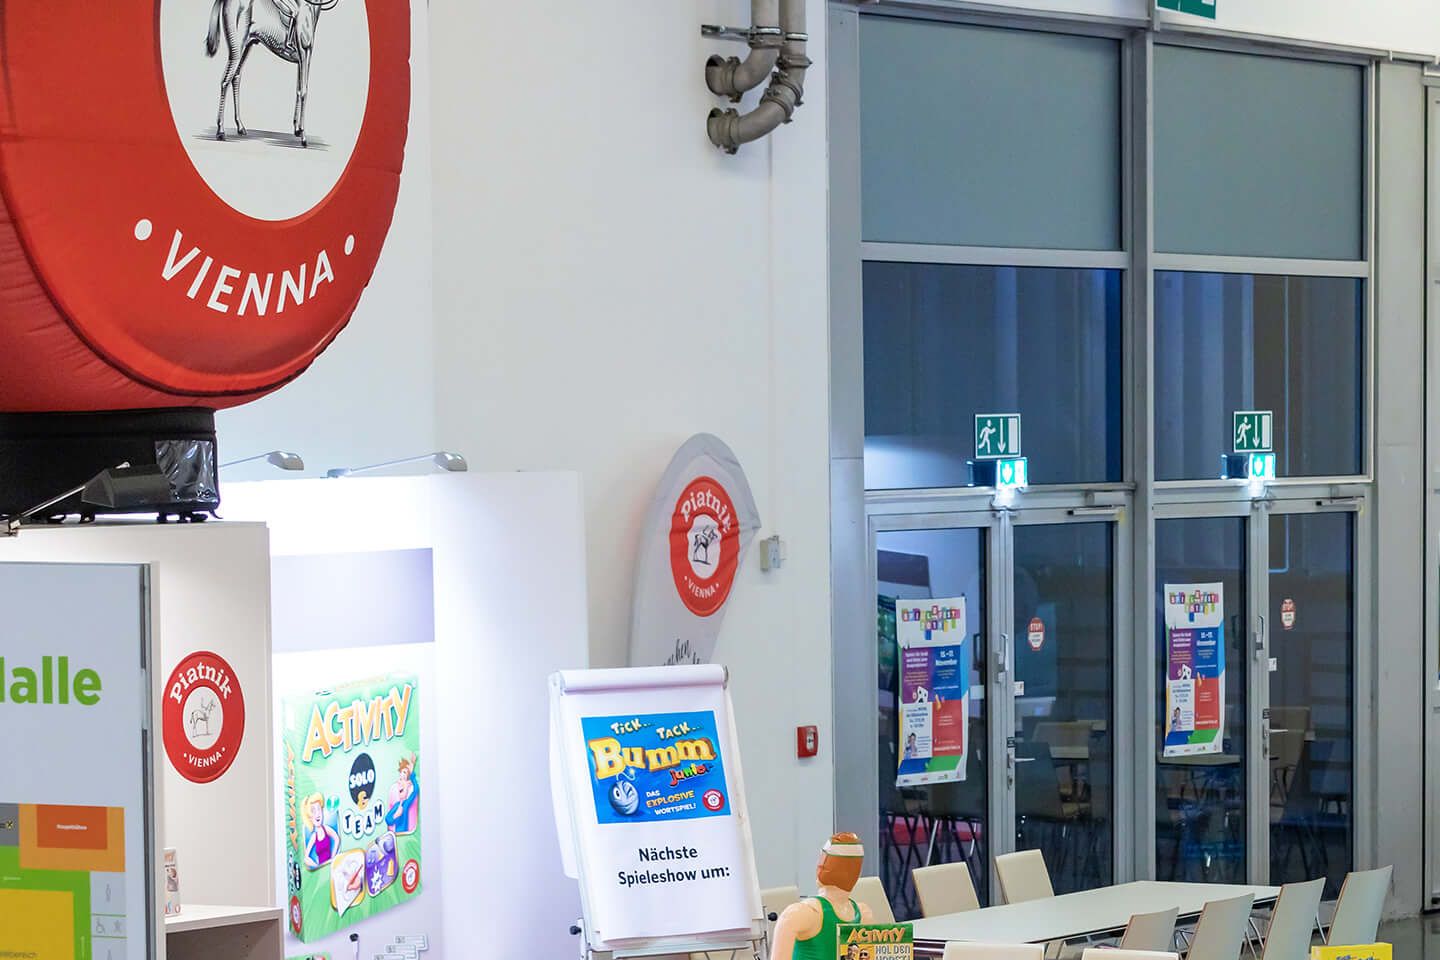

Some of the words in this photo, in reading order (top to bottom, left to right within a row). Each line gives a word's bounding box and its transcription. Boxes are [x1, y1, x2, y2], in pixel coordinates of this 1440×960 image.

[161, 229, 336, 316] VIENNA
[680, 488, 732, 533] Piatnik
[688, 577, 716, 598] VIENNA
[0, 655, 103, 706] alle
[170, 662, 232, 704] Piatnik
[302, 684, 412, 763] ACTIVITY
[188, 751, 222, 768] VIENNA
[588, 737, 717, 780] Bumm
[349, 769, 375, 789] SOLO
[645, 790, 695, 809] EXPLOSIVE
[344, 803, 383, 835] TEAM
[638, 846, 698, 862] Nächste
[618, 868, 697, 888] Spieleshow
[700, 866, 730, 880] um:
[847, 927, 906, 944] ACTIVITY
